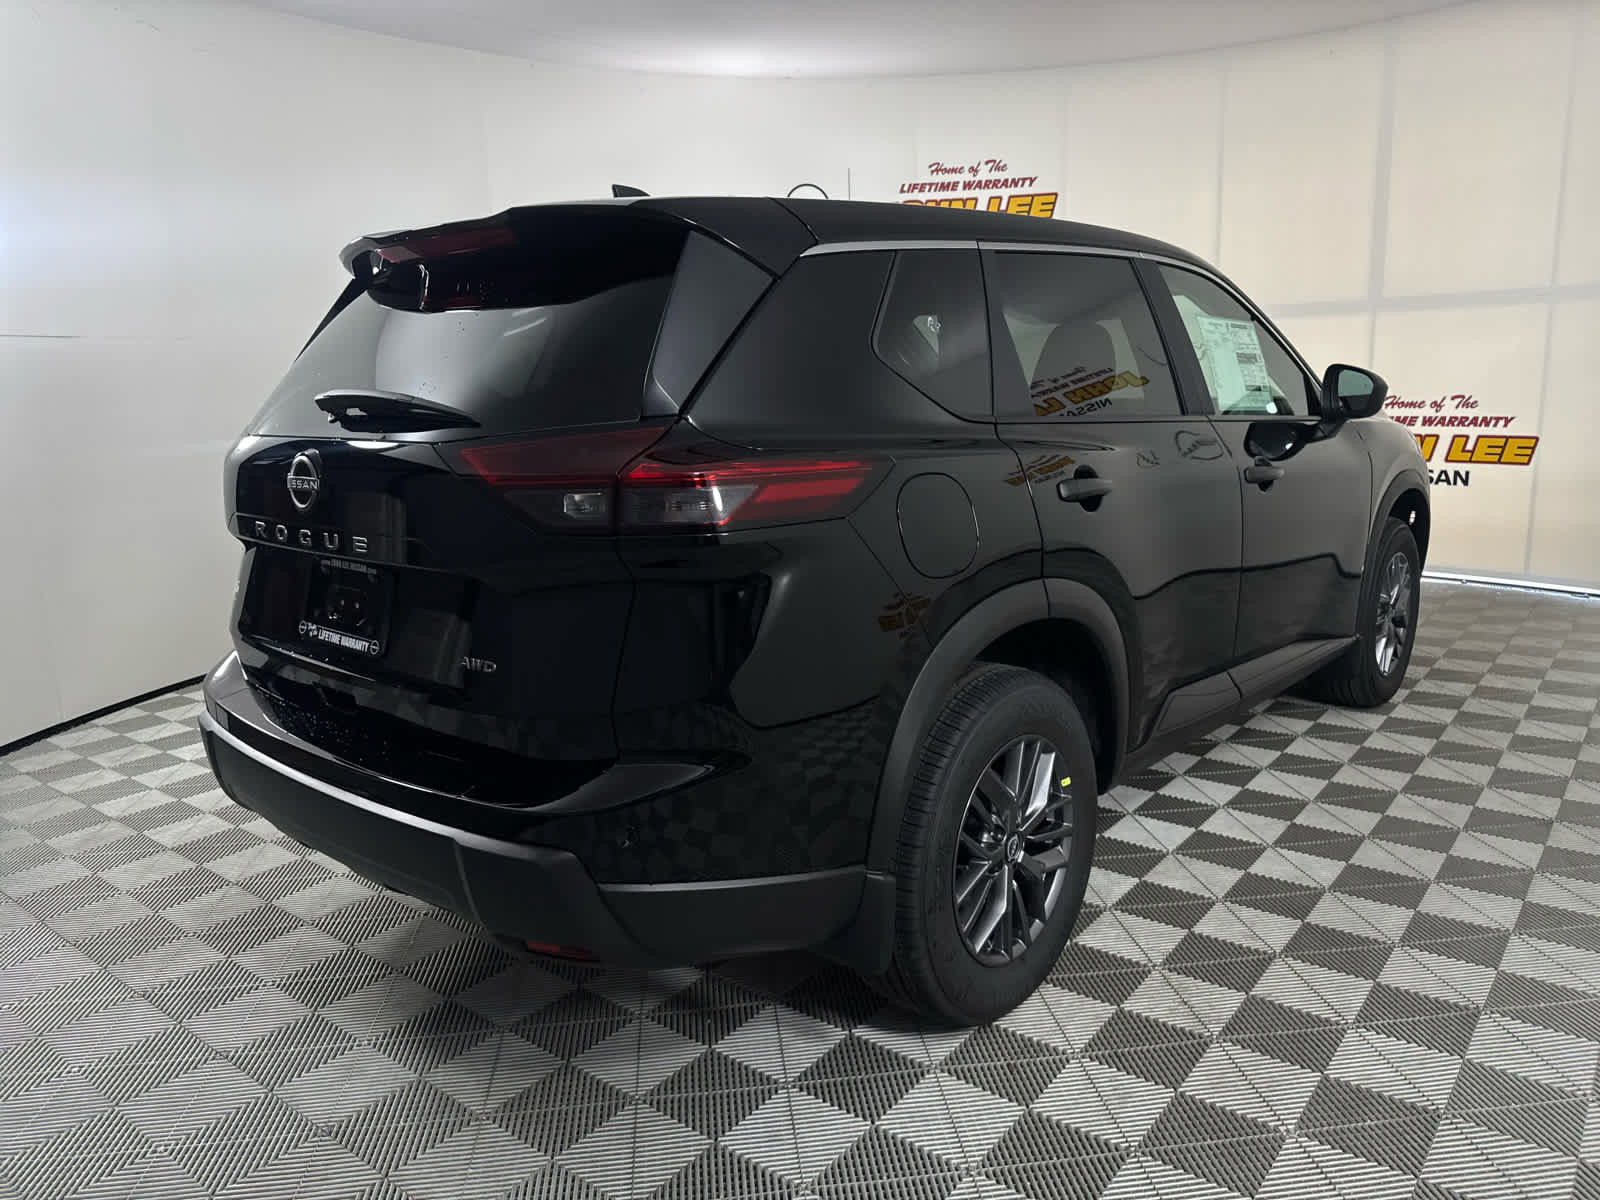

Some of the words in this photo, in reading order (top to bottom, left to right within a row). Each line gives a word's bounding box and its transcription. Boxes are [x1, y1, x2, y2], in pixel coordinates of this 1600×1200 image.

[928, 162, 965, 176] Home
[968, 161, 981, 177] of
[985, 159, 1008, 173] The
[899, 181, 959, 194] LIFETIME
[962, 176, 1038, 191] WARRANTY
[987, 192, 1058, 218] LEE
[1384, 395, 1426, 409] Home
[1430, 396, 1447, 412] of
[1451, 394, 1479, 409] The
[1421, 416, 1515, 428] WARRANTY
[1444, 434, 1539, 466] LEE
[254, 520, 369, 553] ROGUE
